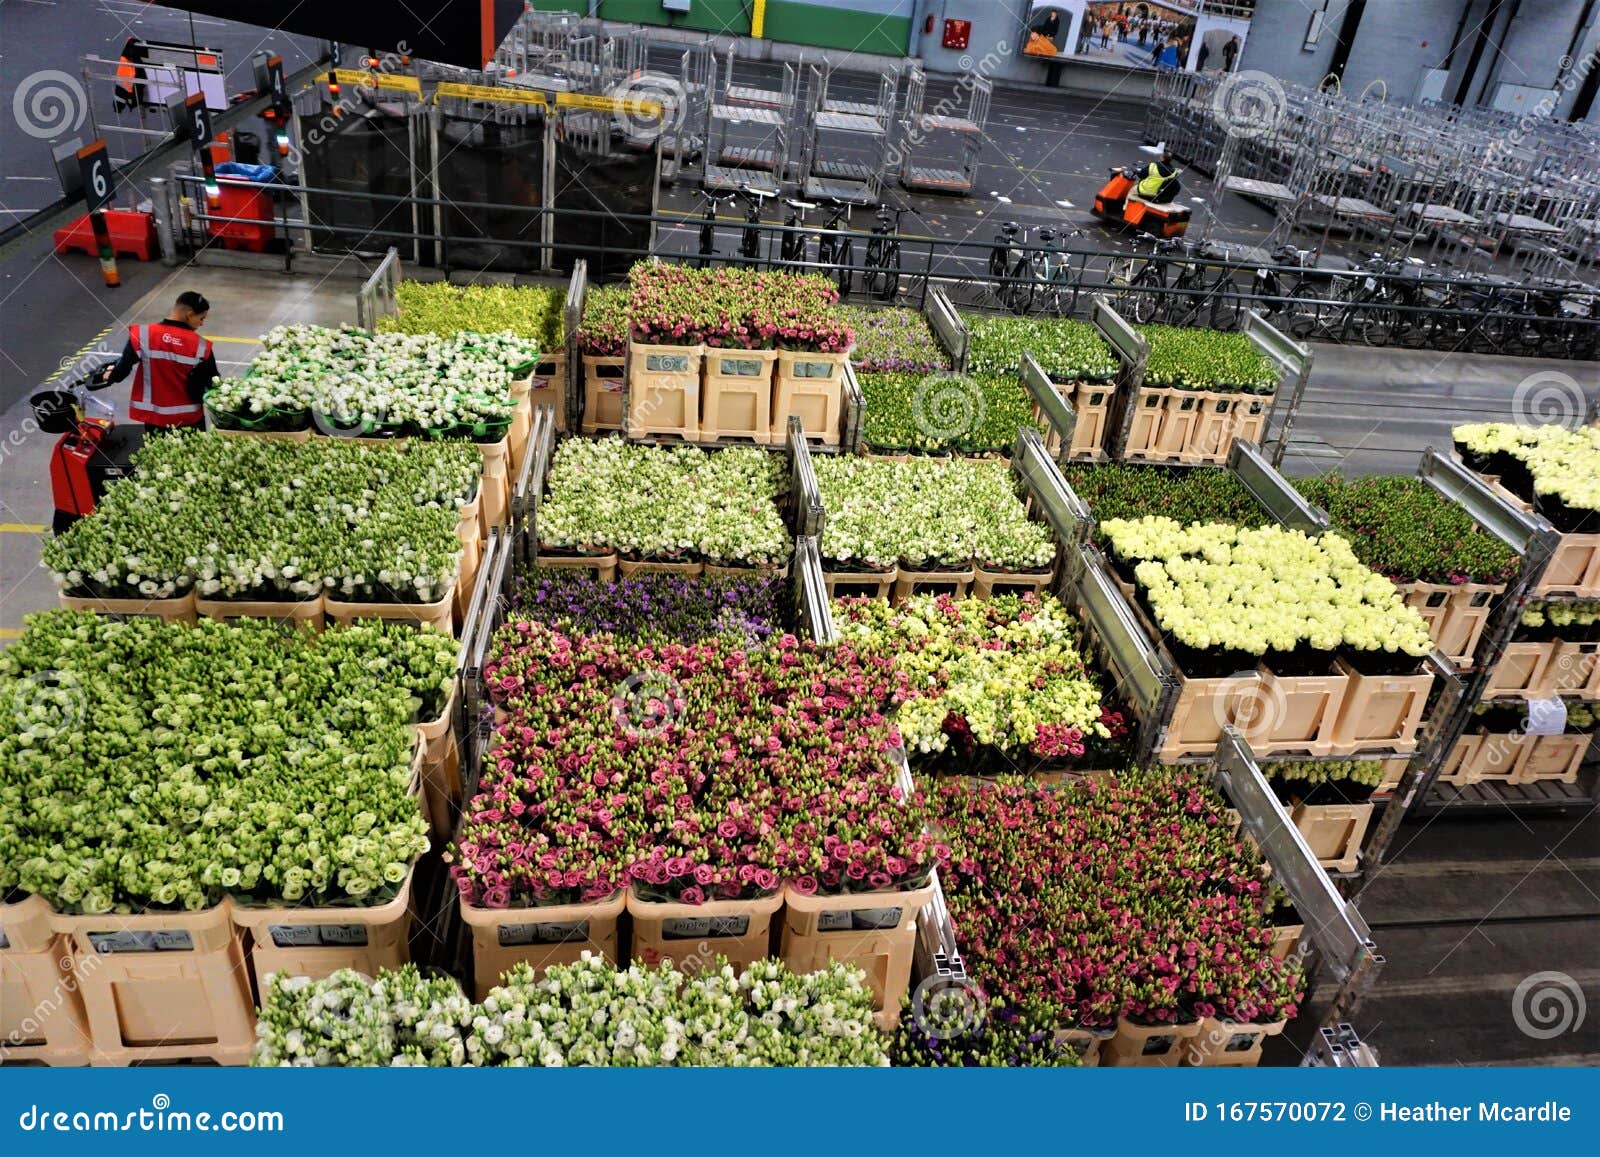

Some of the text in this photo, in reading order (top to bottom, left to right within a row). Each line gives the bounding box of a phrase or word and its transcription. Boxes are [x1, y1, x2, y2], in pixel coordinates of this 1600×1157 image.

[274, 70, 282, 94] 4
[194, 109, 206, 141] 5
[92, 159, 107, 198] 6
